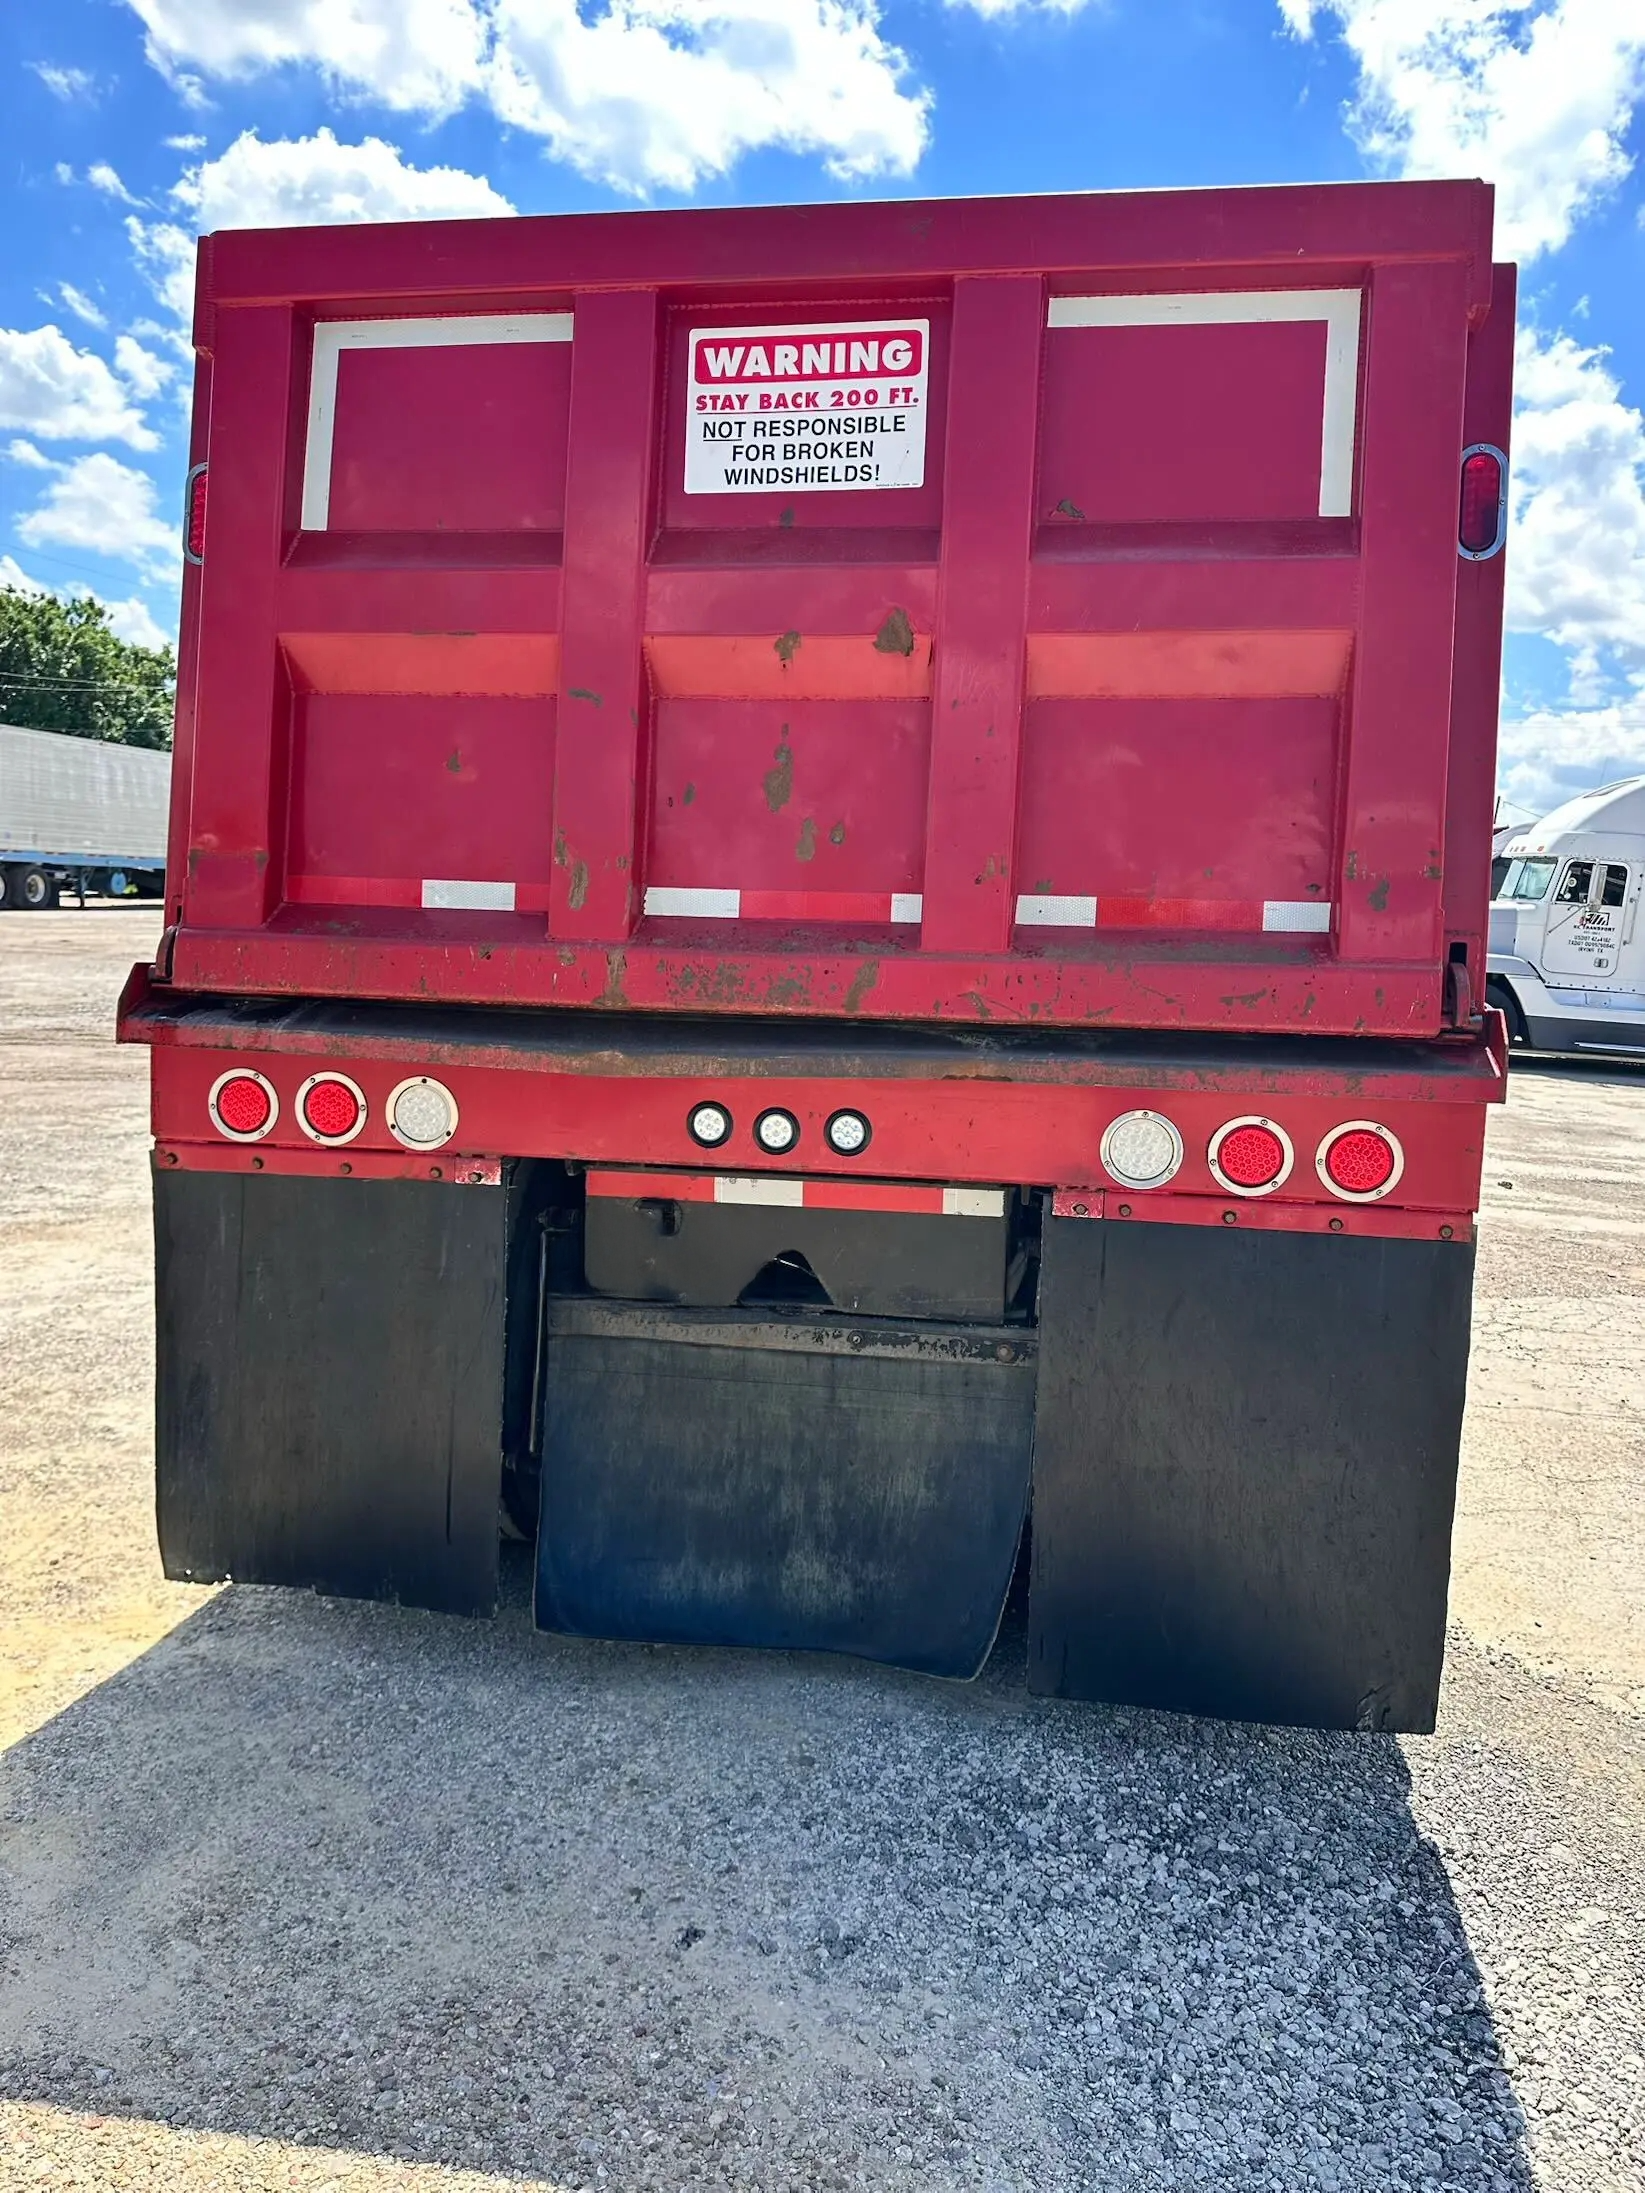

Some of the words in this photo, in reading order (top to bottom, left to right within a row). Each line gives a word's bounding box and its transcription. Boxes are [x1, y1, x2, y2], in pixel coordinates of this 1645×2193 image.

[703, 339, 913, 378] WARNING
[695, 394, 749, 411] STAY
[759, 392, 820, 410] BACK
[830, 389, 879, 407] 200
[889, 387, 920, 404] FT.
[702, 421, 747, 439] NOT
[753, 415, 906, 438] RESPONSIBLE
[732, 444, 776, 462] FOR
[783, 441, 874, 460] BROKEN
[724, 464, 880, 485] WINDSHIELDS!
